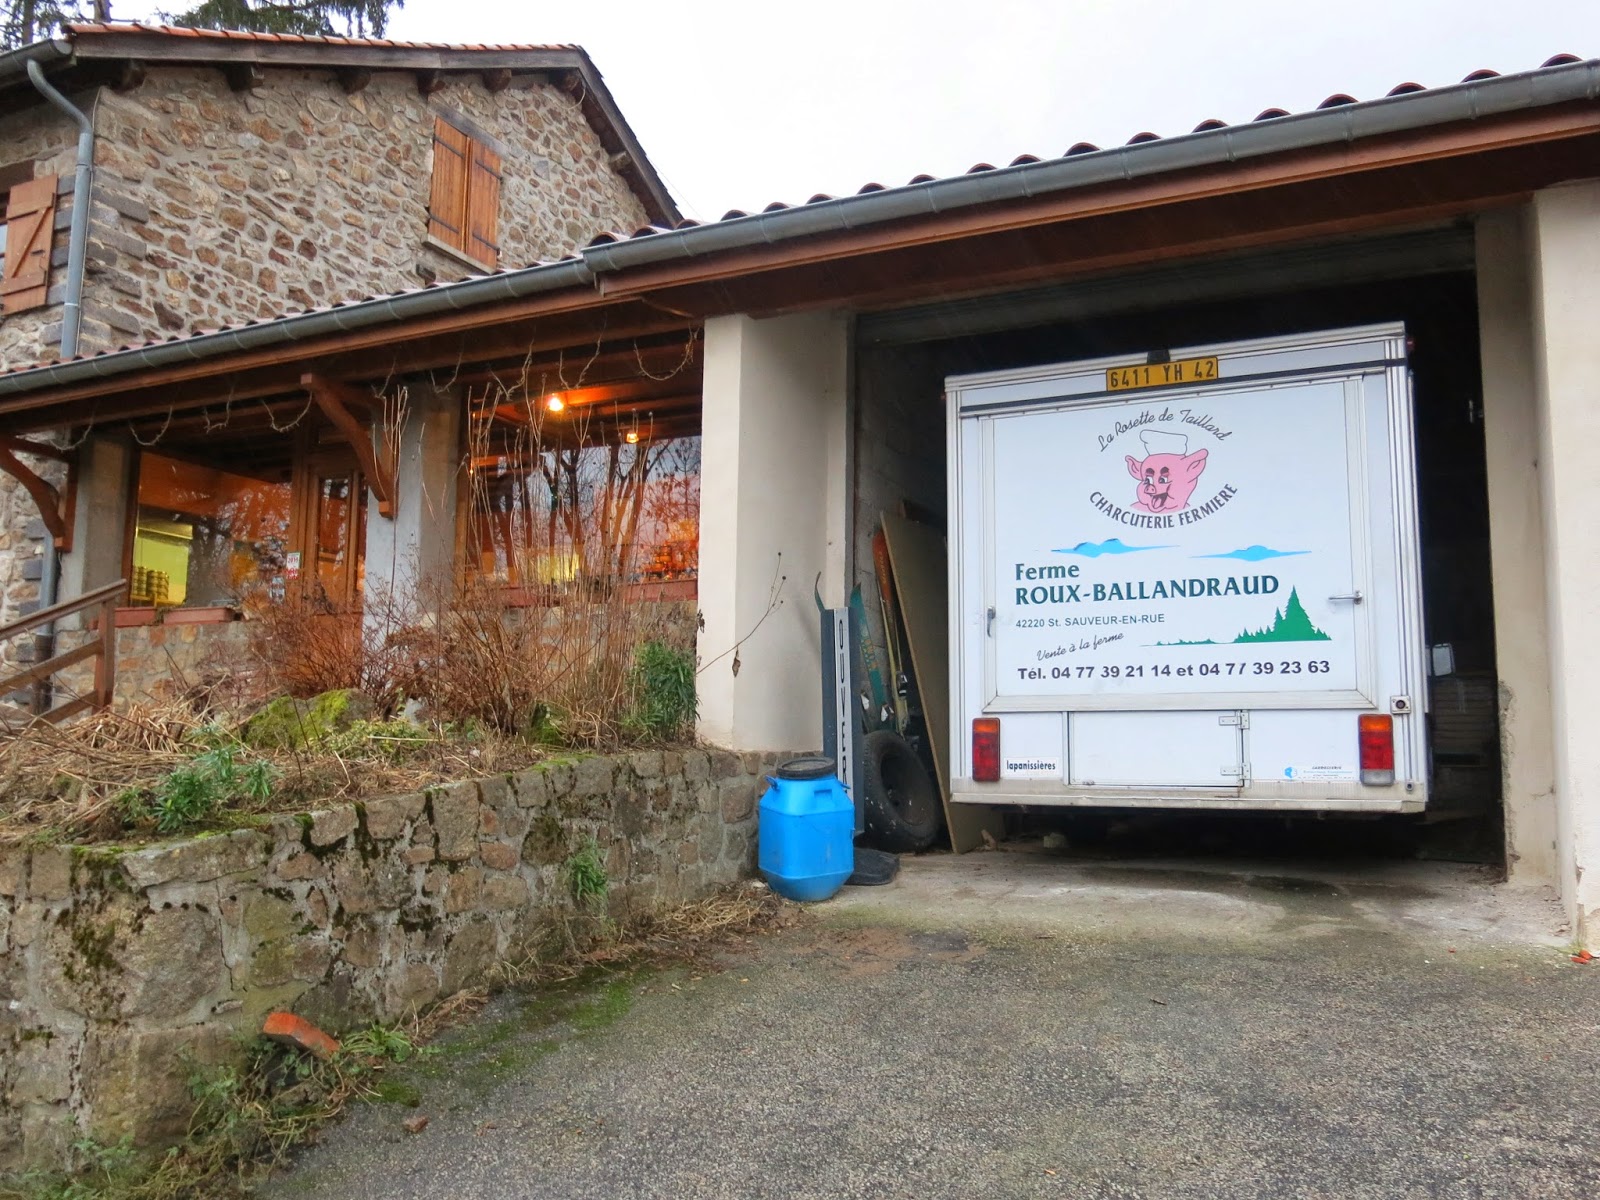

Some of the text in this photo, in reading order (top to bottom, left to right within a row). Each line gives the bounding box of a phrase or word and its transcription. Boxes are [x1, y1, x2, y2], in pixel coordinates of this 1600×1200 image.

[1110, 360, 1214, 388] 6411 YH 42
[1098, 407, 1233, 453] La Rosette de Taillard
[1089, 491, 1175, 529] CHARCUTERIE
[1015, 563, 1080, 581] Ferme
[1015, 575, 1279, 606] ROUX-BALLANDRAUD
[1015, 613, 1165, 628] 42220 St. SAUVEUR-EN-RUE
[1036, 632, 1125, 661] Vente à la ferme
[1017, 660, 1330, 680] Tél. 04 77 39 21 14 et 04 77 39 23 63
[1006, 759, 1056, 773] lapanissières
